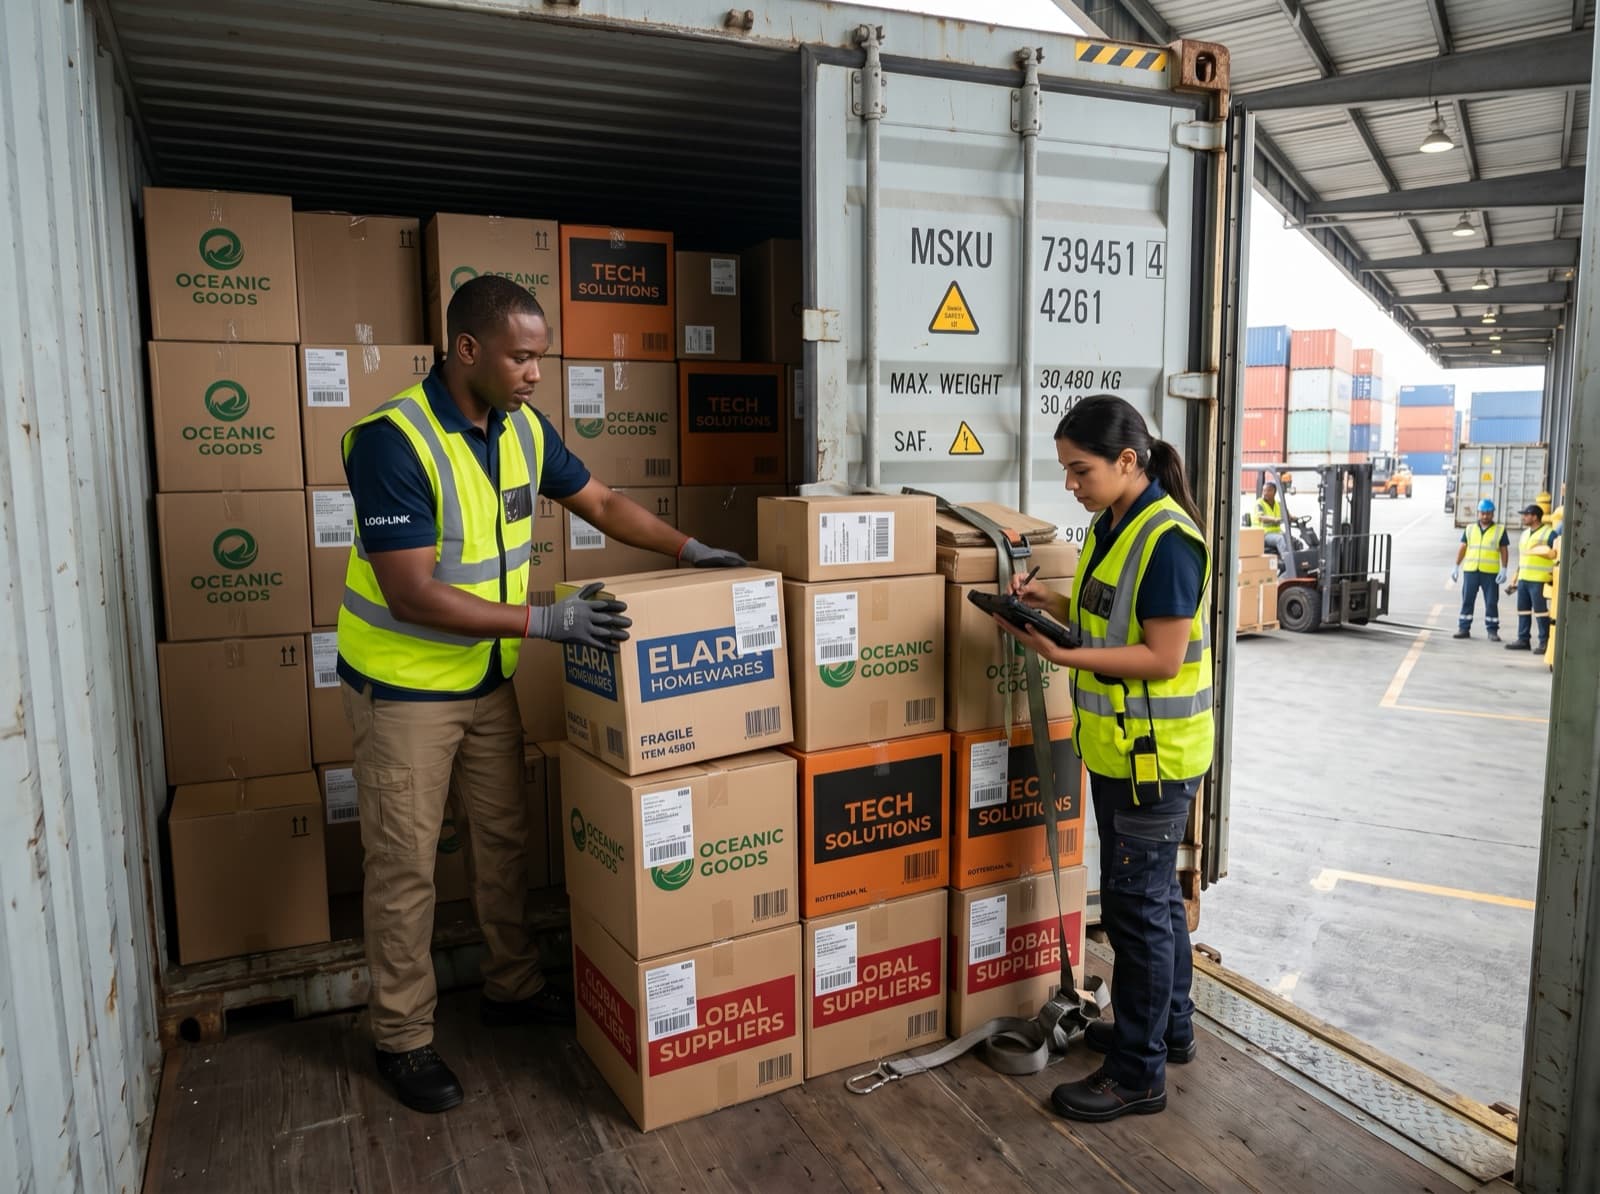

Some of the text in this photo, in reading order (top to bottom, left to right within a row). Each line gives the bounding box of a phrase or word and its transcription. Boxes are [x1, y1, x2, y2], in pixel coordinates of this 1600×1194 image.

[911, 227, 1163, 276] MSKU 739451 4
[176, 273, 271, 291] OCEANIC
[592, 263, 646, 283] TECH
[192, 291, 258, 305] GOODS
[578, 282, 660, 298] SOLUTIONS
[1040, 287, 1102, 324] 4261
[890, 369, 1122, 396] MAX. WEIGHT 30,480 KG
[709, 396, 758, 413] TECH
[607, 411, 669, 424] OCEANIC
[696, 414, 771, 428] SOLUTIONS
[182, 426, 275, 440] OCEANIC
[607, 424, 657, 437] GOODS
[894, 430, 933, 452] SAF.
[198, 443, 263, 455] GOODS
[365, 515, 411, 527] LOGI-LINK
[191, 572, 283, 590] OCEANIC
[206, 589, 270, 604] GOODS
[860, 640, 934, 661] OCEANIC
[651, 660, 764, 692] HOMEWARES
[860, 658, 919, 678] GOODS
[997, 675, 1050, 694] GOOS
[640, 726, 694, 746] FRAGILE
[641, 741, 696, 760] ITEM 45801
[844, 792, 913, 825] TECH
[586, 823, 624, 861] OCEANIC
[699, 828, 784, 858] OCEANIC
[825, 815, 931, 850] SOLUTIONS
[587, 841, 617, 873] GOODS
[700, 850, 769, 877] GOODS
[815, 889, 858, 903] ROTTERDAM,
[1005, 928, 1060, 955] OBAL
[857, 955, 919, 985] OBAL
[585, 968, 624, 1025] GLOBAL
[822, 972, 932, 1016] SUPPLIERS
[580, 981, 632, 1056] SUPPLIERS
[697, 995, 769, 1029] OBAL
[659, 1012, 785, 1063] SUPPLIERS
